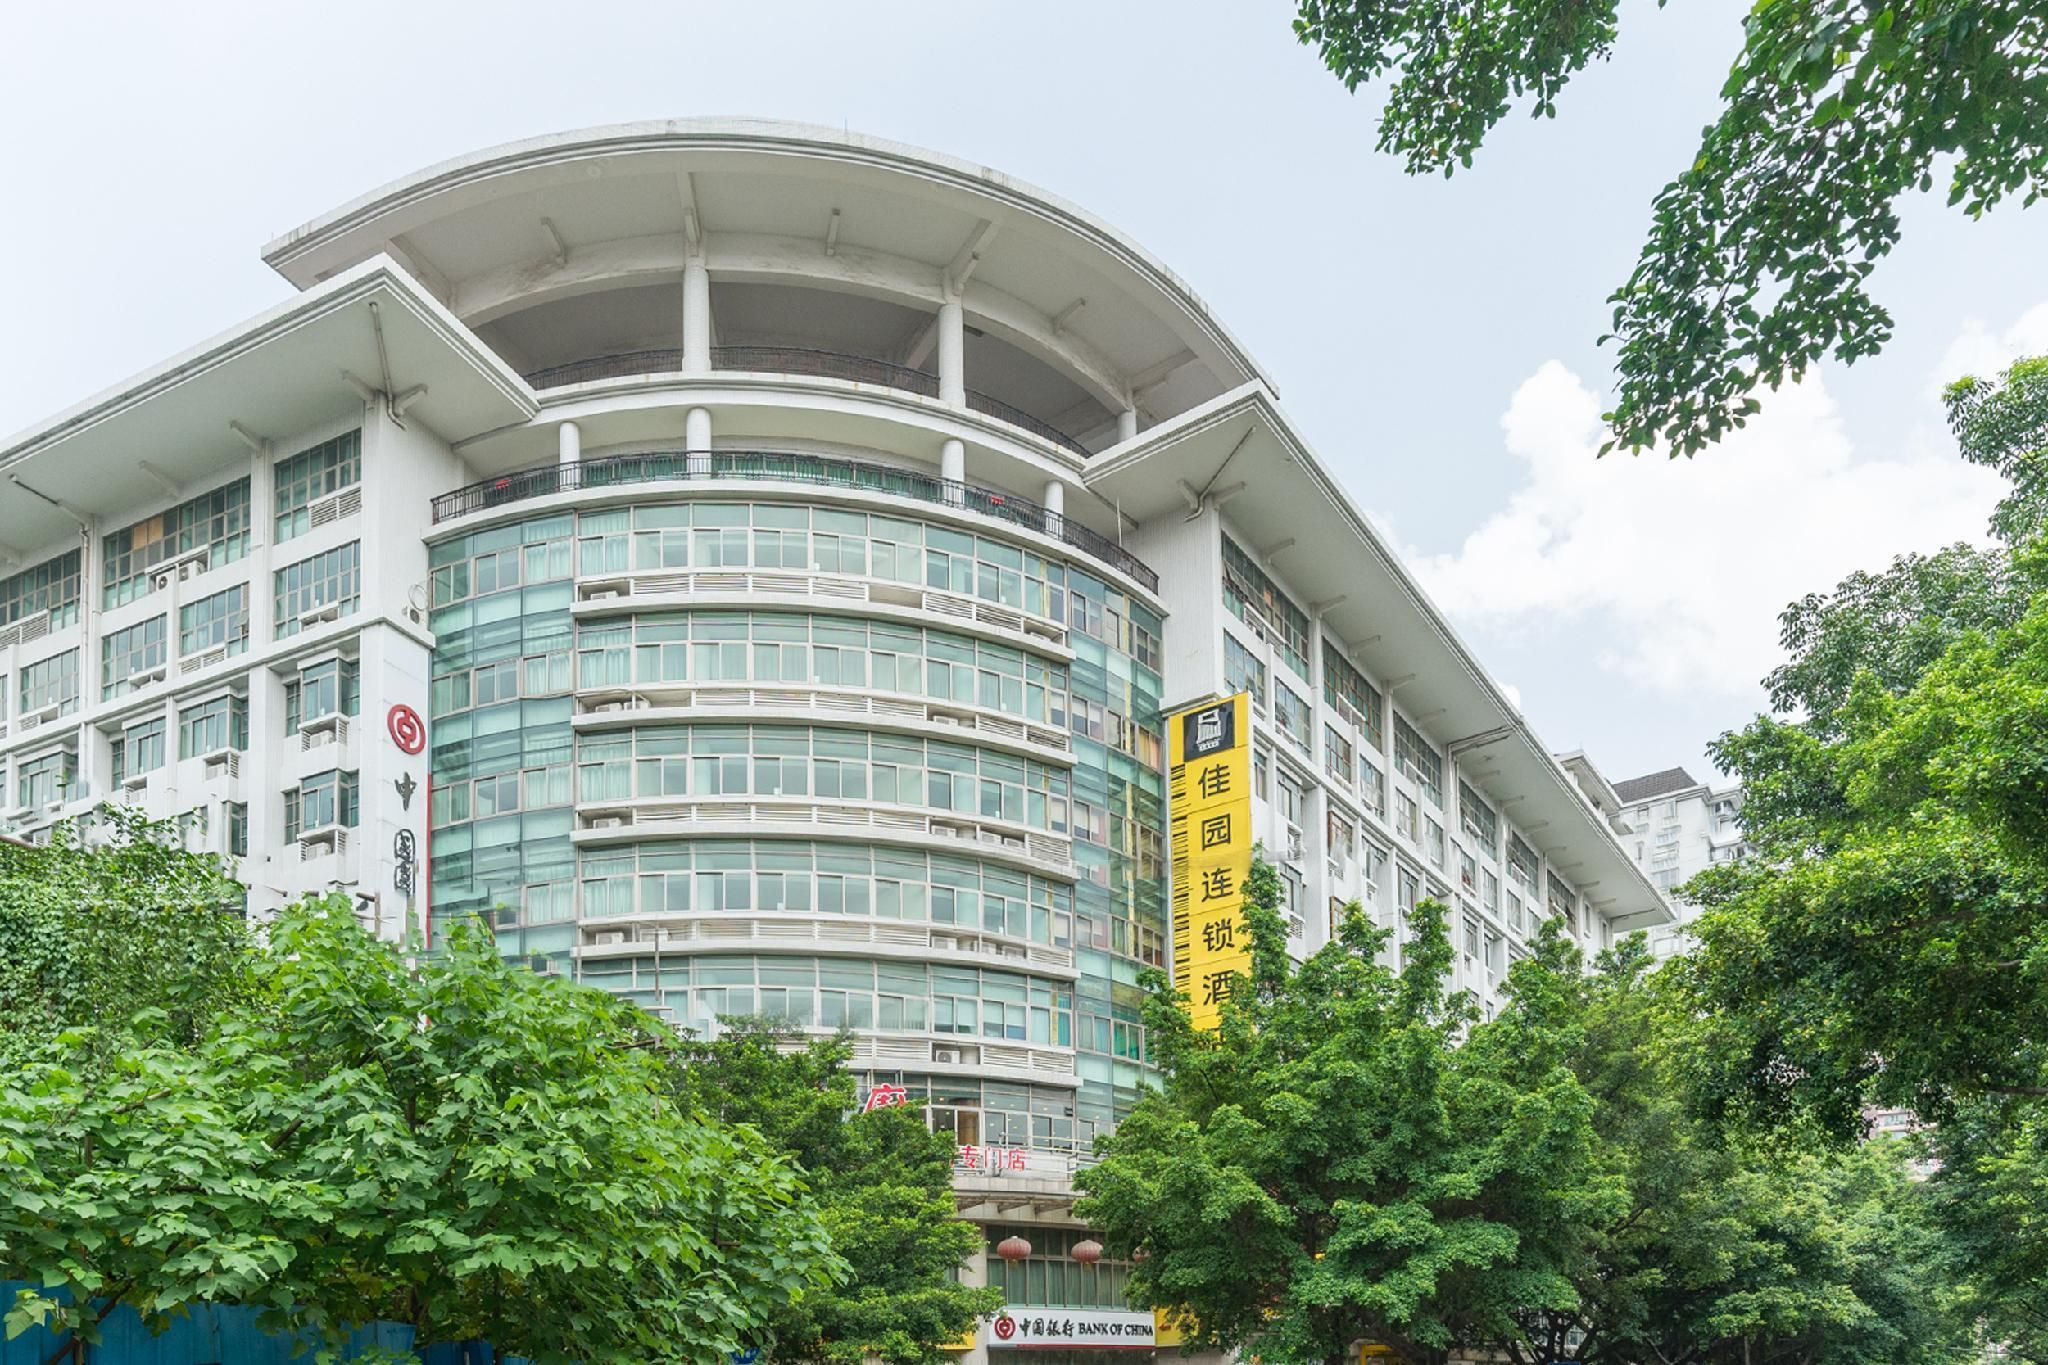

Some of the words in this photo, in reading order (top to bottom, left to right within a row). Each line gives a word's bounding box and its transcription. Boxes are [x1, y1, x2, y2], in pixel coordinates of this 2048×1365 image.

[1198, 763, 1234, 1051] 佳园连锁酒
[949, 1145, 1025, 1171] 专门店
[1019, 1318, 1074, 1338] 中国银行
[1078, 1322, 1108, 1335] BANK
[1110, 1323, 1123, 1335] OF
[1124, 1324, 1153, 1336] CHINA
